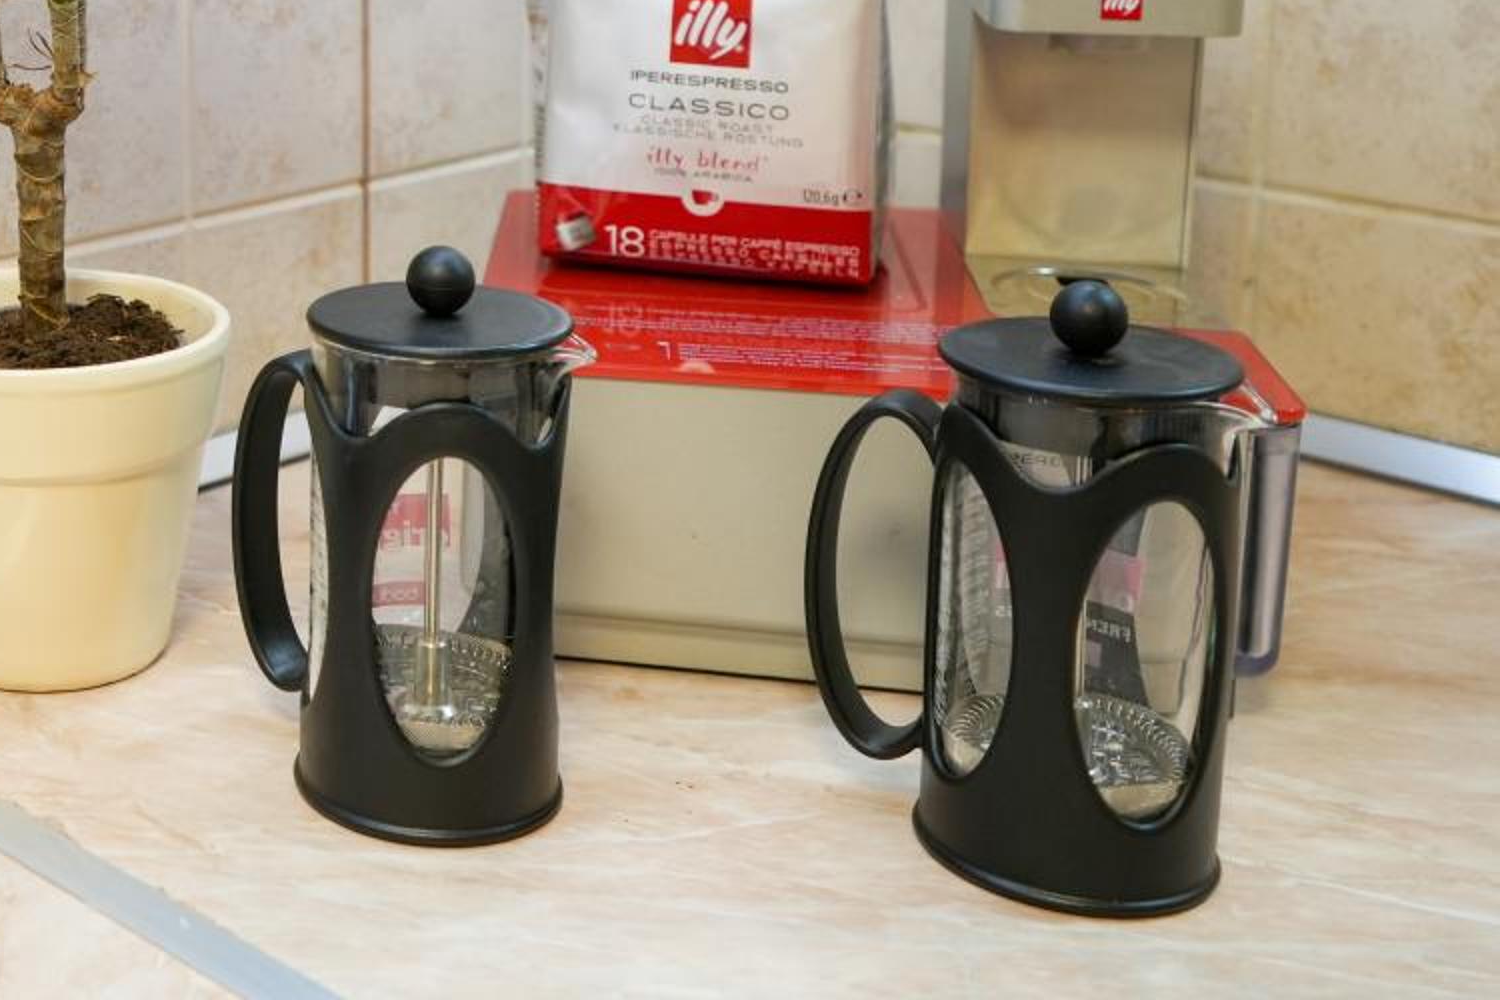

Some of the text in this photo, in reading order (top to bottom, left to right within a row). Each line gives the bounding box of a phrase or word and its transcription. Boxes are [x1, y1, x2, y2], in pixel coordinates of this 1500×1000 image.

[630, 70, 789, 94] IPERESPRESSO
[628, 93, 790, 121] CLASSICO
[604, 224, 645, 258] 18
